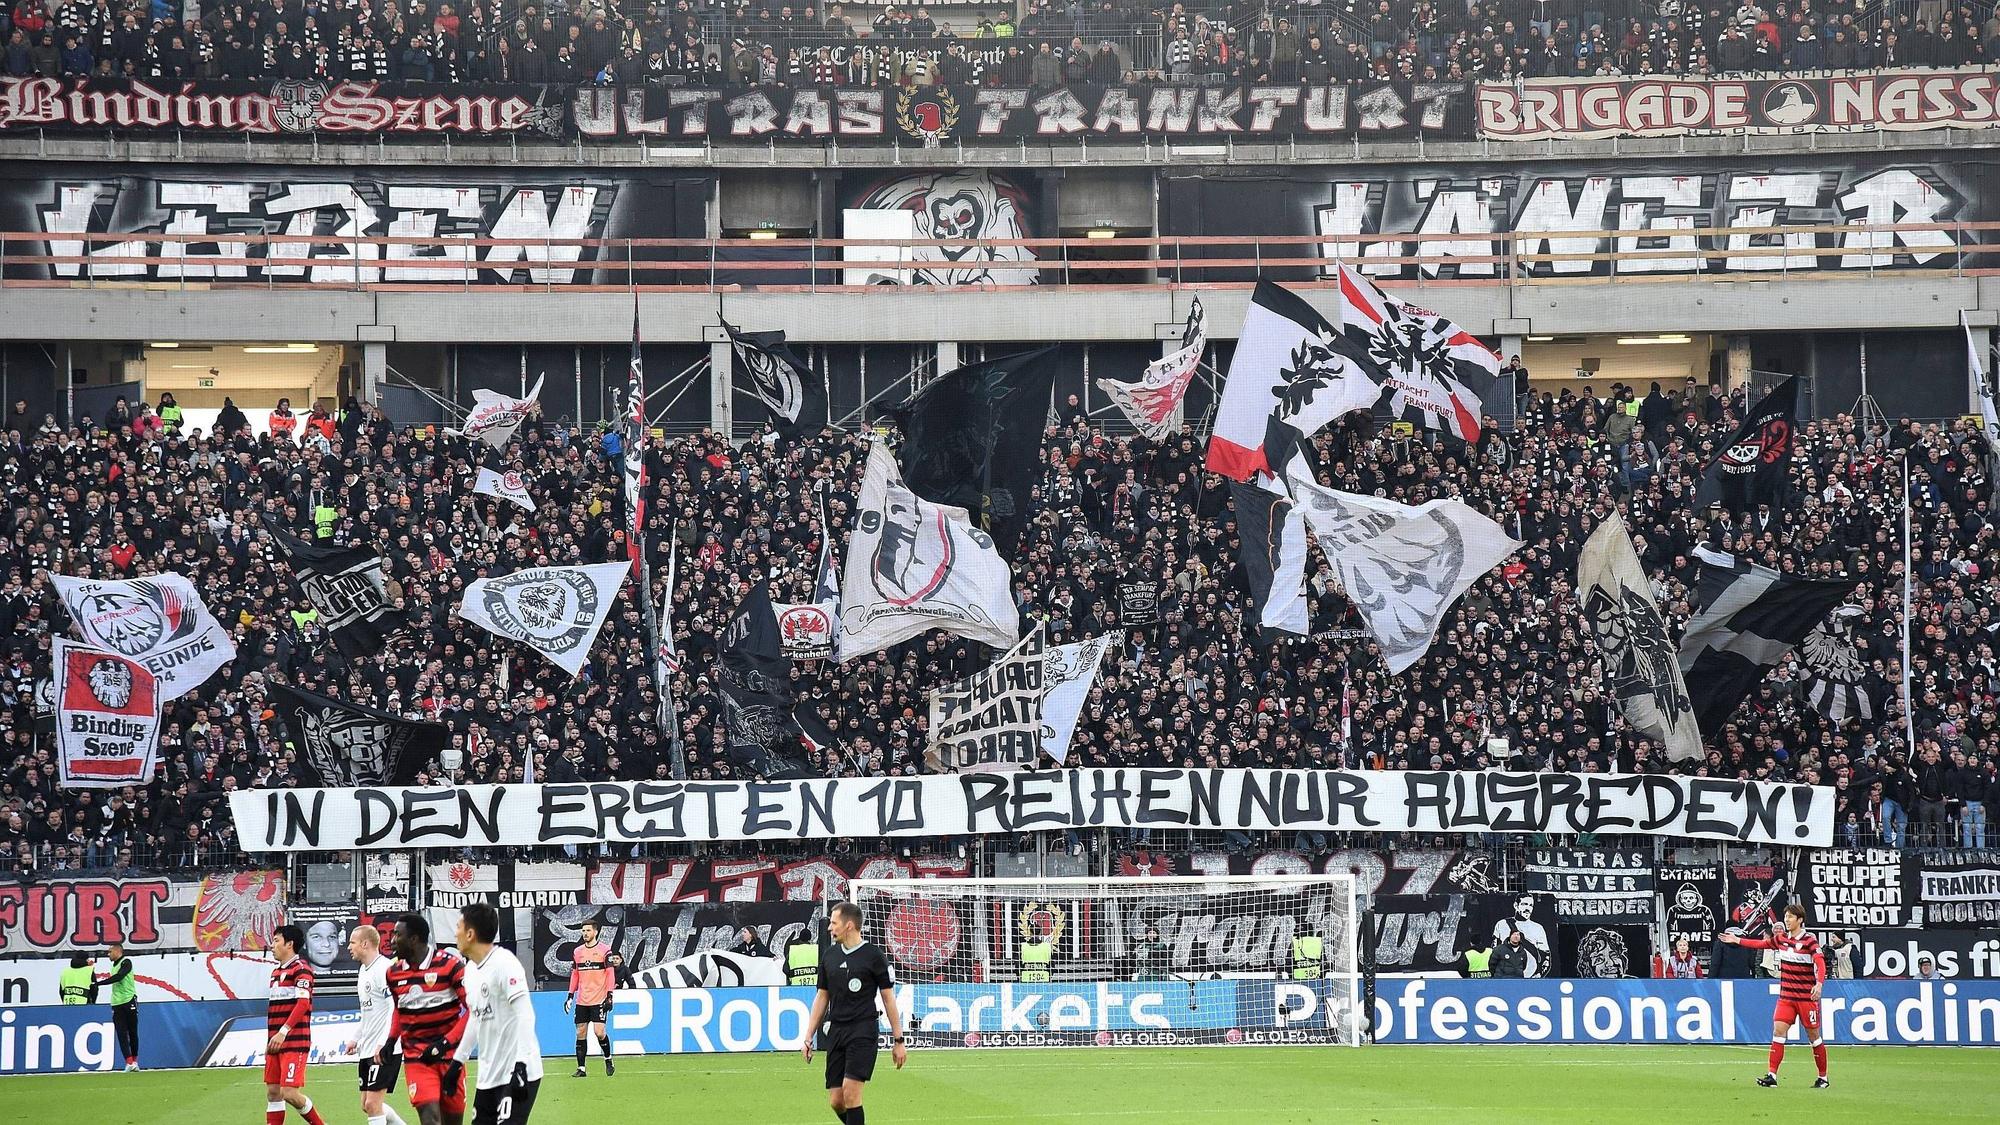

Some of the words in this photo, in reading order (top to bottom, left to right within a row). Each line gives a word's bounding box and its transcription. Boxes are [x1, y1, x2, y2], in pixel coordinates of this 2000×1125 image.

[0, 77, 279, 133] Binding
[320, 82, 530, 132] Szene
[575, 86, 884, 135] ULTRAS
[975, 83, 1466, 135] FRANKFURT
[1478, 82, 1749, 134] BRIGADE
[1830, 75, 2000, 125] NASS
[70, 714, 145, 740] Binding
[84, 737, 135, 756] Szene
[266, 790, 325, 846] IN
[354, 786, 506, 846] DEN
[538, 779, 839, 842] ERSTEN
[859, 779, 925, 835] 10
[963, 770, 1225, 833] REIHEN
[1239, 772, 1380, 827] NUR
[1404, 772, 1815, 841] AUSREDEN!
[1536, 850, 1643, 868] ULTRAS
[1546, 874, 1636, 891] NEVER
[1660, 868, 1716, 880] EXTREME
[1811, 865, 1900, 887] GRUPPE
[500, 890, 577, 908] GUARDIA
[1814, 886, 1902, 904] STADION
[1555, 899, 1650, 916] RRENDER
[1814, 904, 1901, 925] VERBOT
[1669, 931, 1711, 942] FANS
[1863, 940, 1959, 977] Jobs
[0, 1010, 115, 1071] ing
[983, 1034, 1002, 1046] LG
[1007, 1034, 1045, 1046] OLED
[1047, 1038, 1064, 1046] evo
[1114, 1033, 1133, 1045] LG
[1138, 1033, 1176, 1045] OLED
[1178, 1036, 1195, 1044] evo
[1245, 1031, 1265, 1043] LG
[1269, 1031, 1307, 1043] OLED
[1309, 1035, 1326, 1043] evo
[287, 1063, 296, 1078] 3
